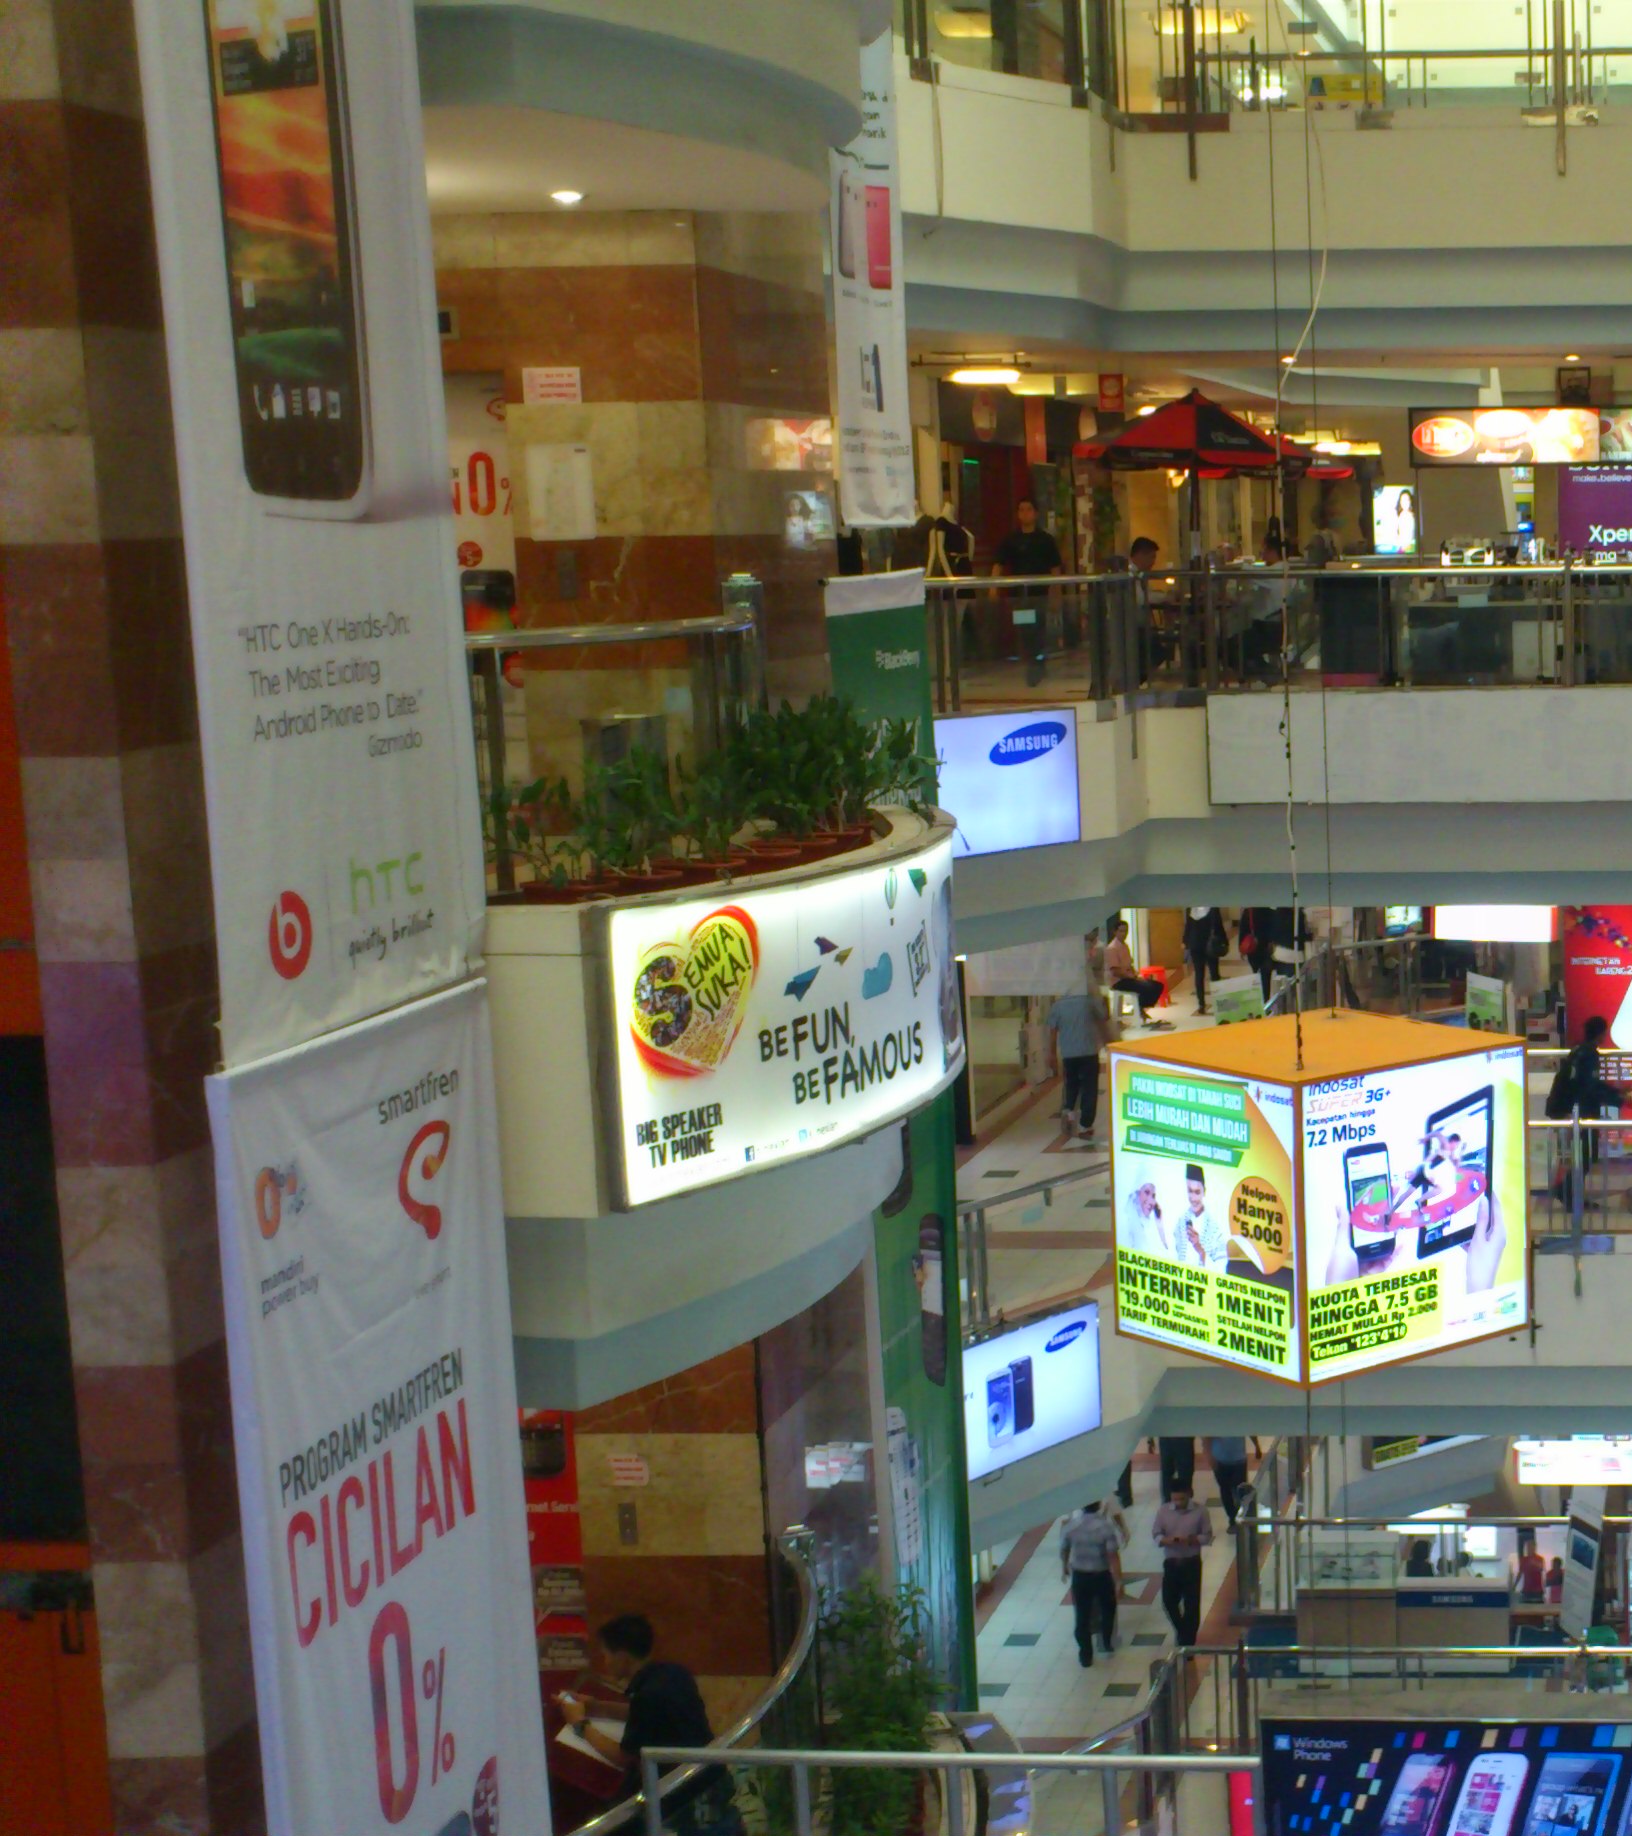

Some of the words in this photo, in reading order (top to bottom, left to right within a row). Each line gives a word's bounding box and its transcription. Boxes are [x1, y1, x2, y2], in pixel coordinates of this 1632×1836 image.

[287, 621, 319, 649] One
[322, 618, 334, 645] X
[249, 669, 281, 698] The
[286, 663, 322, 692] Most
[326, 658, 381, 686] Exciting
[253, 708, 317, 742] Android
[321, 700, 363, 730] Phone
[367, 701, 380, 720] to
[999, 733, 1059, 754] SAMSUNG
[350, 852, 424, 915] htc
[347, 931, 389, 968] quietly
[391, 909, 436, 945] brilliant
[377, 1069, 460, 1126] smartfren
[636, 1119, 659, 1147] BIG
[661, 1102, 723, 1141] SPEAKER
[1127, 1096, 1155, 1121] LEBIH
[1155, 1102, 1190, 1130] MURAH
[1190, 1110, 1212, 1135] DAN
[1212, 1116, 1249, 1143] MUDAH
[1306, 1129, 1328, 1148] 7.2
[1332, 1123, 1376, 1142] Mbps
[649, 1142, 668, 1169] TV
[671, 1130, 716, 1163] PHONE
[1236, 1197, 1283, 1226] Hanya
[1241, 1184, 1278, 1203] Nelpon
[1118, 1249, 1185, 1279] BLACKBERRY
[1186, 1268, 1209, 1286] DAN
[1118, 1264, 1206, 1307] INTERNET
[1216, 1277, 1249, 1295] GRATIS
[1250, 1286, 1287, 1306] NELPON
[1310, 1287, 1360, 1311] KUOTA
[1364, 1268, 1438, 1297] TERBESAR
[1310, 1298, 1380, 1329] HINGGA
[1385, 1290, 1409, 1310] 7.5
[1414, 1283, 1438, 1302] GB
[1120, 1305, 1148, 1323] TARIF
[1150, 1314, 1211, 1343] TERMURAH!
[1216, 1314, 1253, 1333] SETELAH
[1253, 1324, 1287, 1343] NELPON
[1310, 1323, 1349, 1342] HEMAT
[1352, 1314, 1388, 1332] MULAI
[1217, 1327, 1229, 1347] 2
[1229, 1331, 1287, 1365] MENIT
[279, 1413, 368, 1509] PROGRAM
[371, 1348, 465, 1446] SMARTFREN
[286, 1399, 477, 1650] CICILAN
[367, 1600, 456, 1826] 0%
[1292, 1736, 1349, 1750] Windows
[1293, 1748, 1332, 1761] Phone
